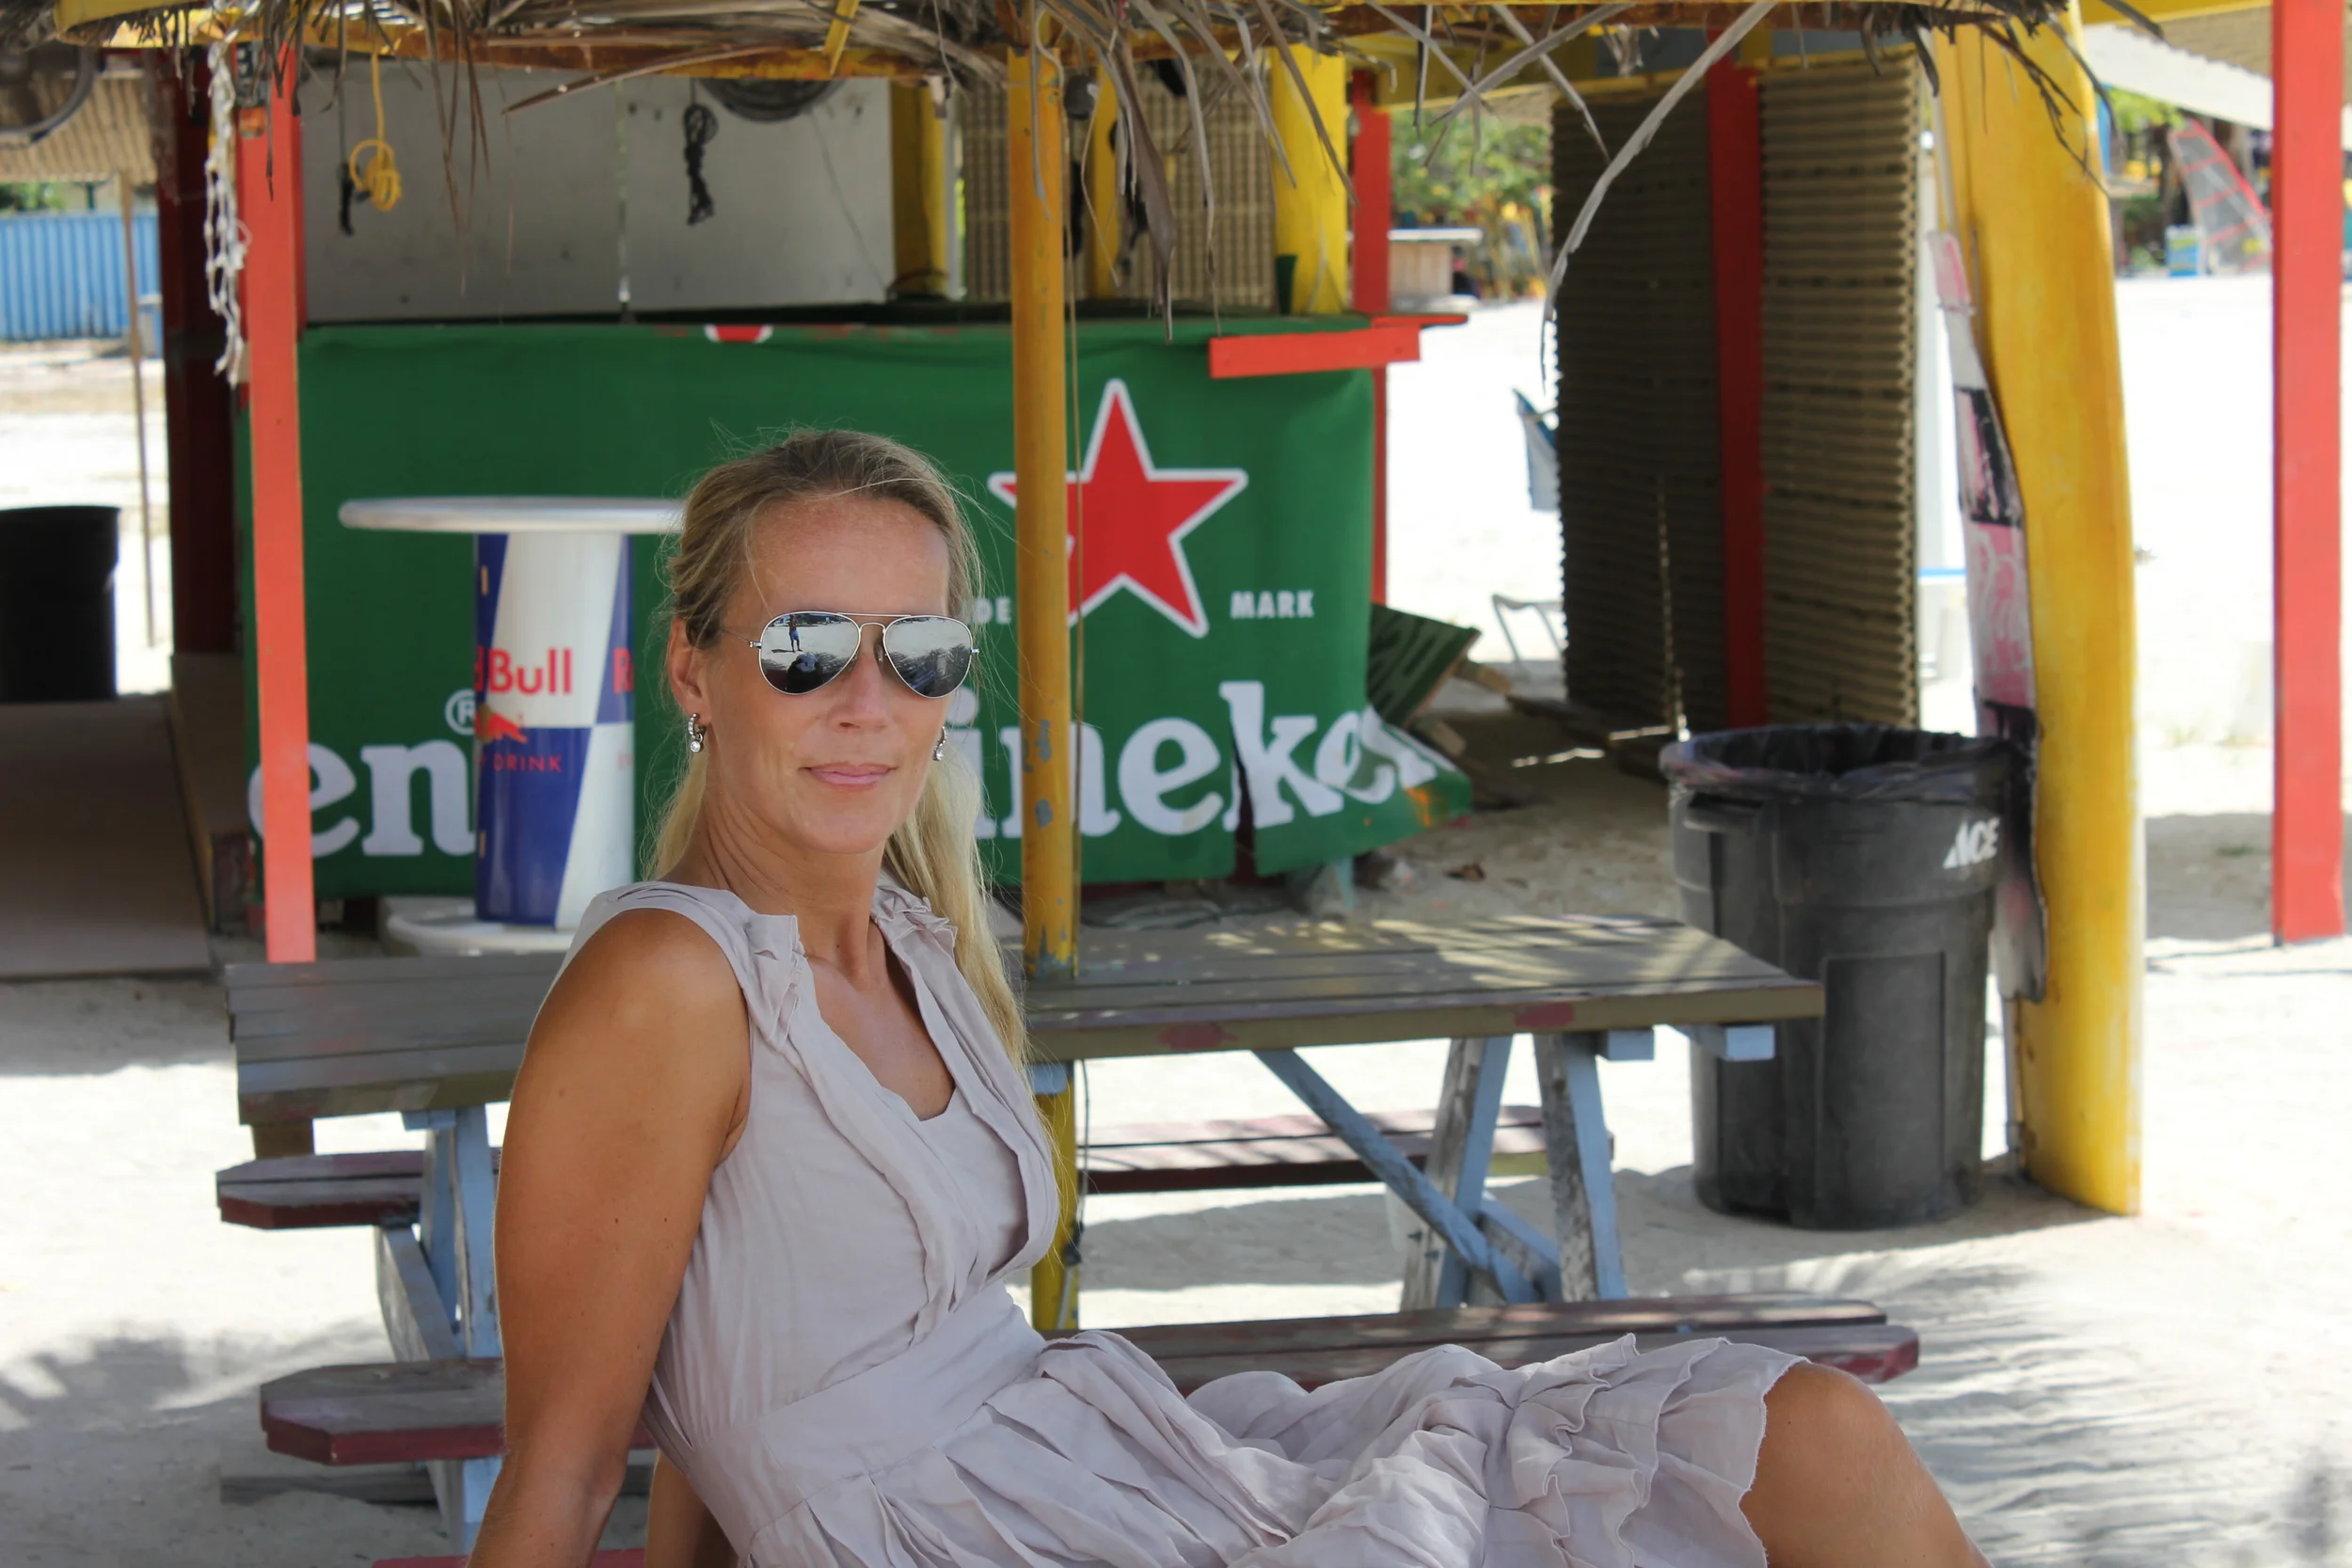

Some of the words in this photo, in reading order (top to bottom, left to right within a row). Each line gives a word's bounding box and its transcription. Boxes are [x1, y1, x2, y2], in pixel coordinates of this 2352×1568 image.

[1231, 590, 1315, 619] MARK
[493, 754, 563, 772] DRINK
[1943, 816, 2000, 869] ACE
